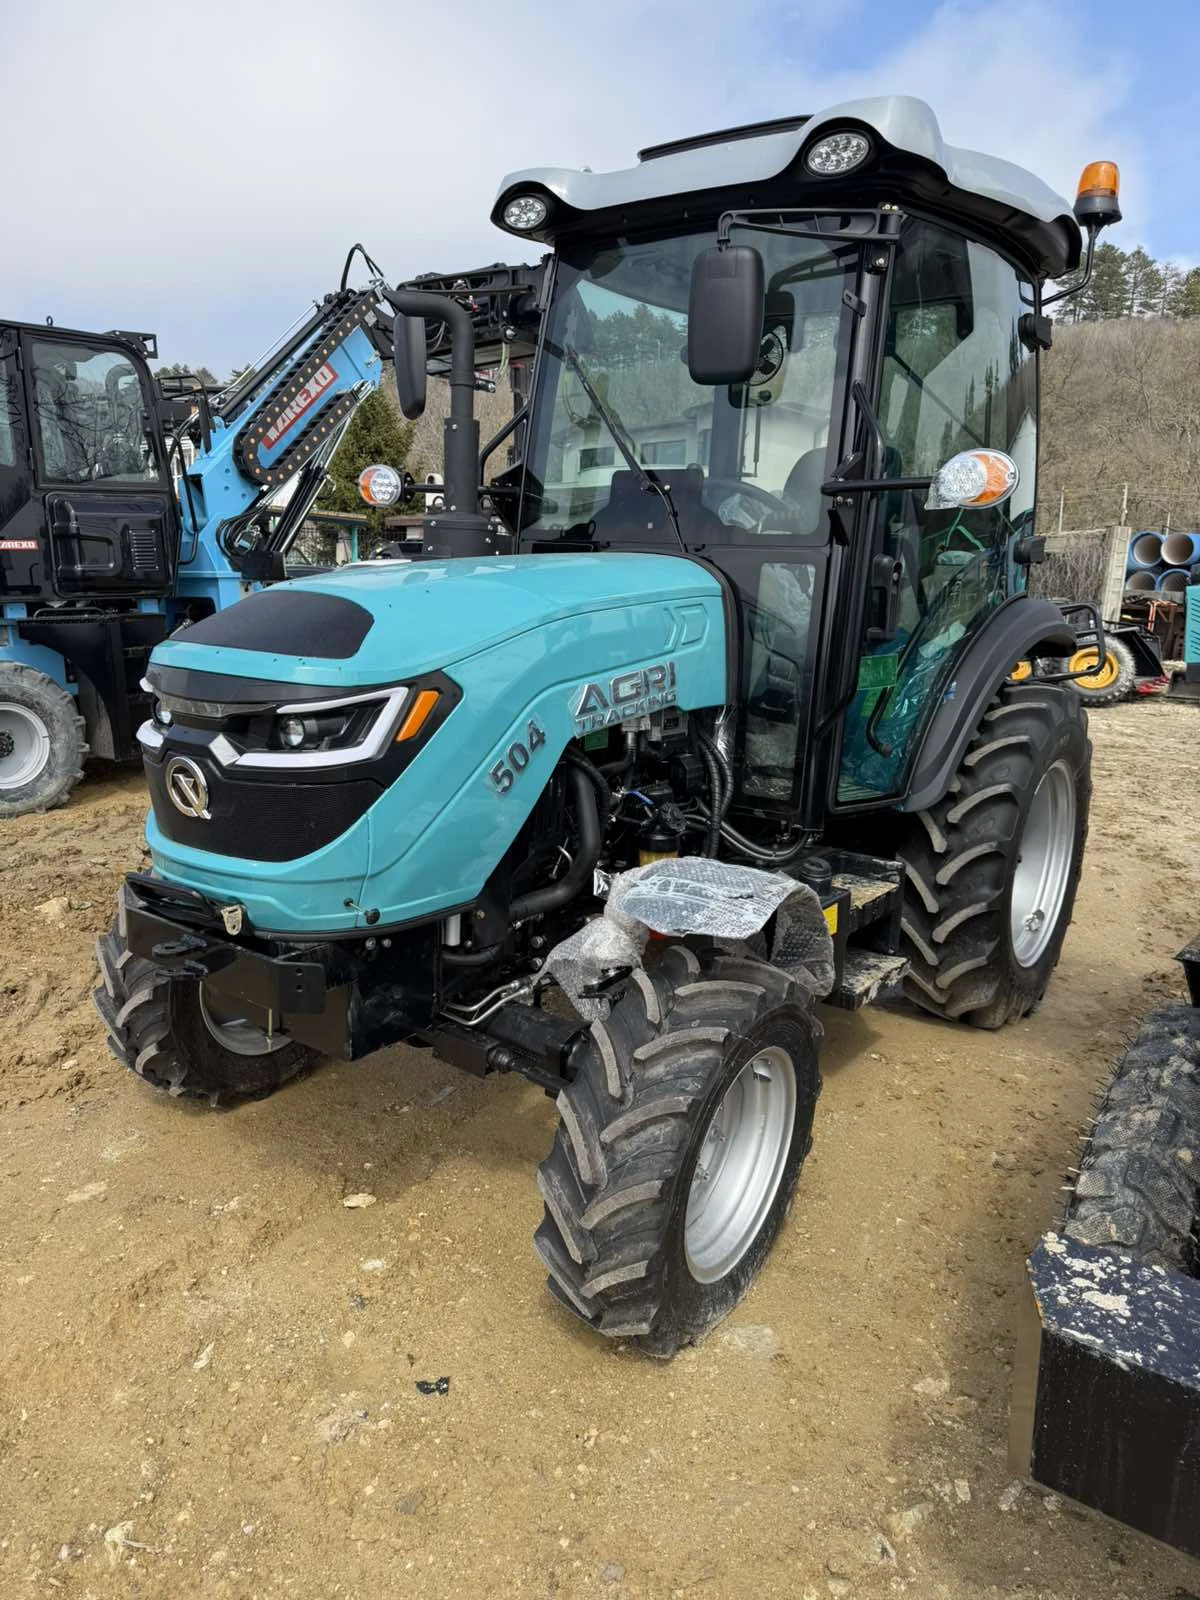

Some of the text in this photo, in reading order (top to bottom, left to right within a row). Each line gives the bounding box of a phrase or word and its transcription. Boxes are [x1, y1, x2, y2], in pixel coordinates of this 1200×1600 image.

[574, 661, 676, 716] AGRI
[575, 690, 677, 731] TRACKING
[490, 719, 546, 794] 504
